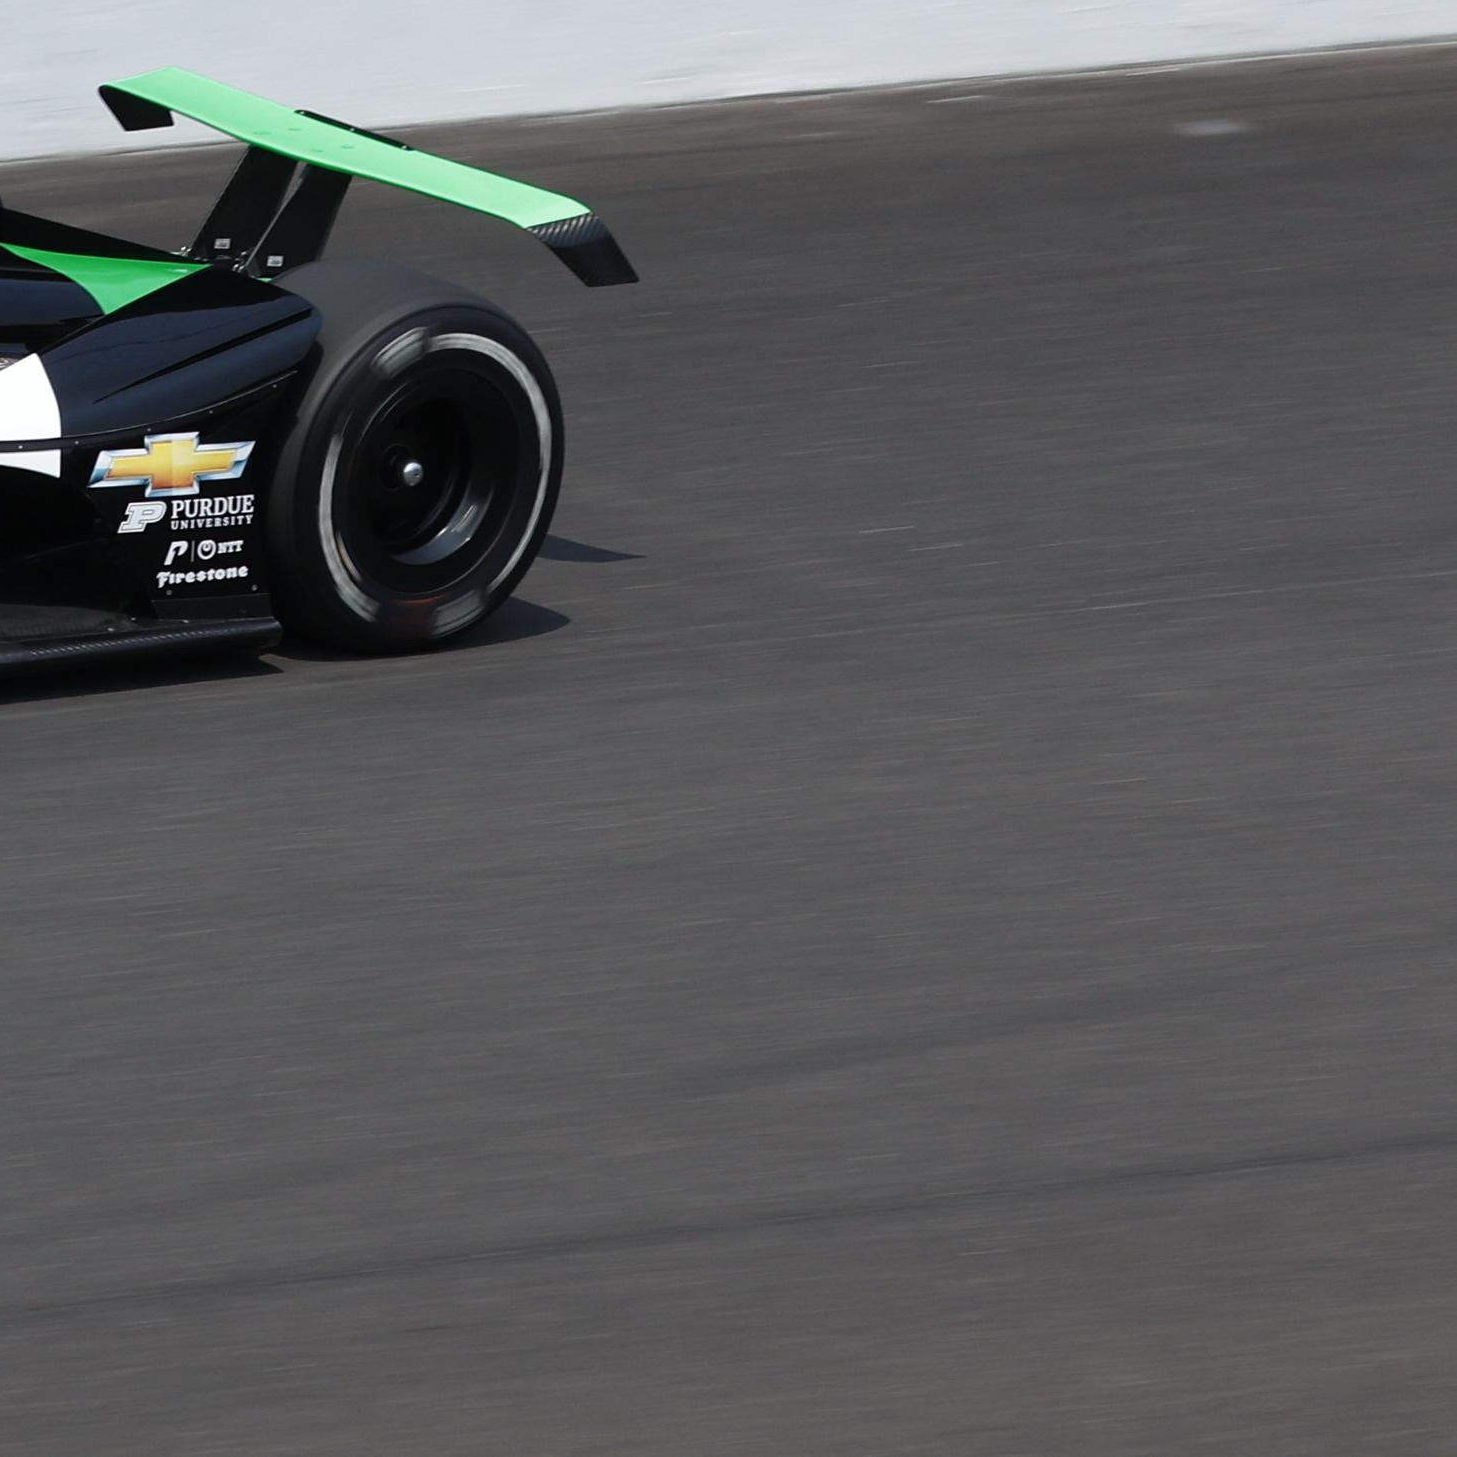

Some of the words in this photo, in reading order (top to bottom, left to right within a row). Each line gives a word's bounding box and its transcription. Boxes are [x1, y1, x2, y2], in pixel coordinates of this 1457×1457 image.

[171, 494, 255, 519] PURDUE
[170, 515, 254, 530] UNIVERSITY
[217, 540, 244, 554] NTT
[156, 566, 248, 588] Firestone
